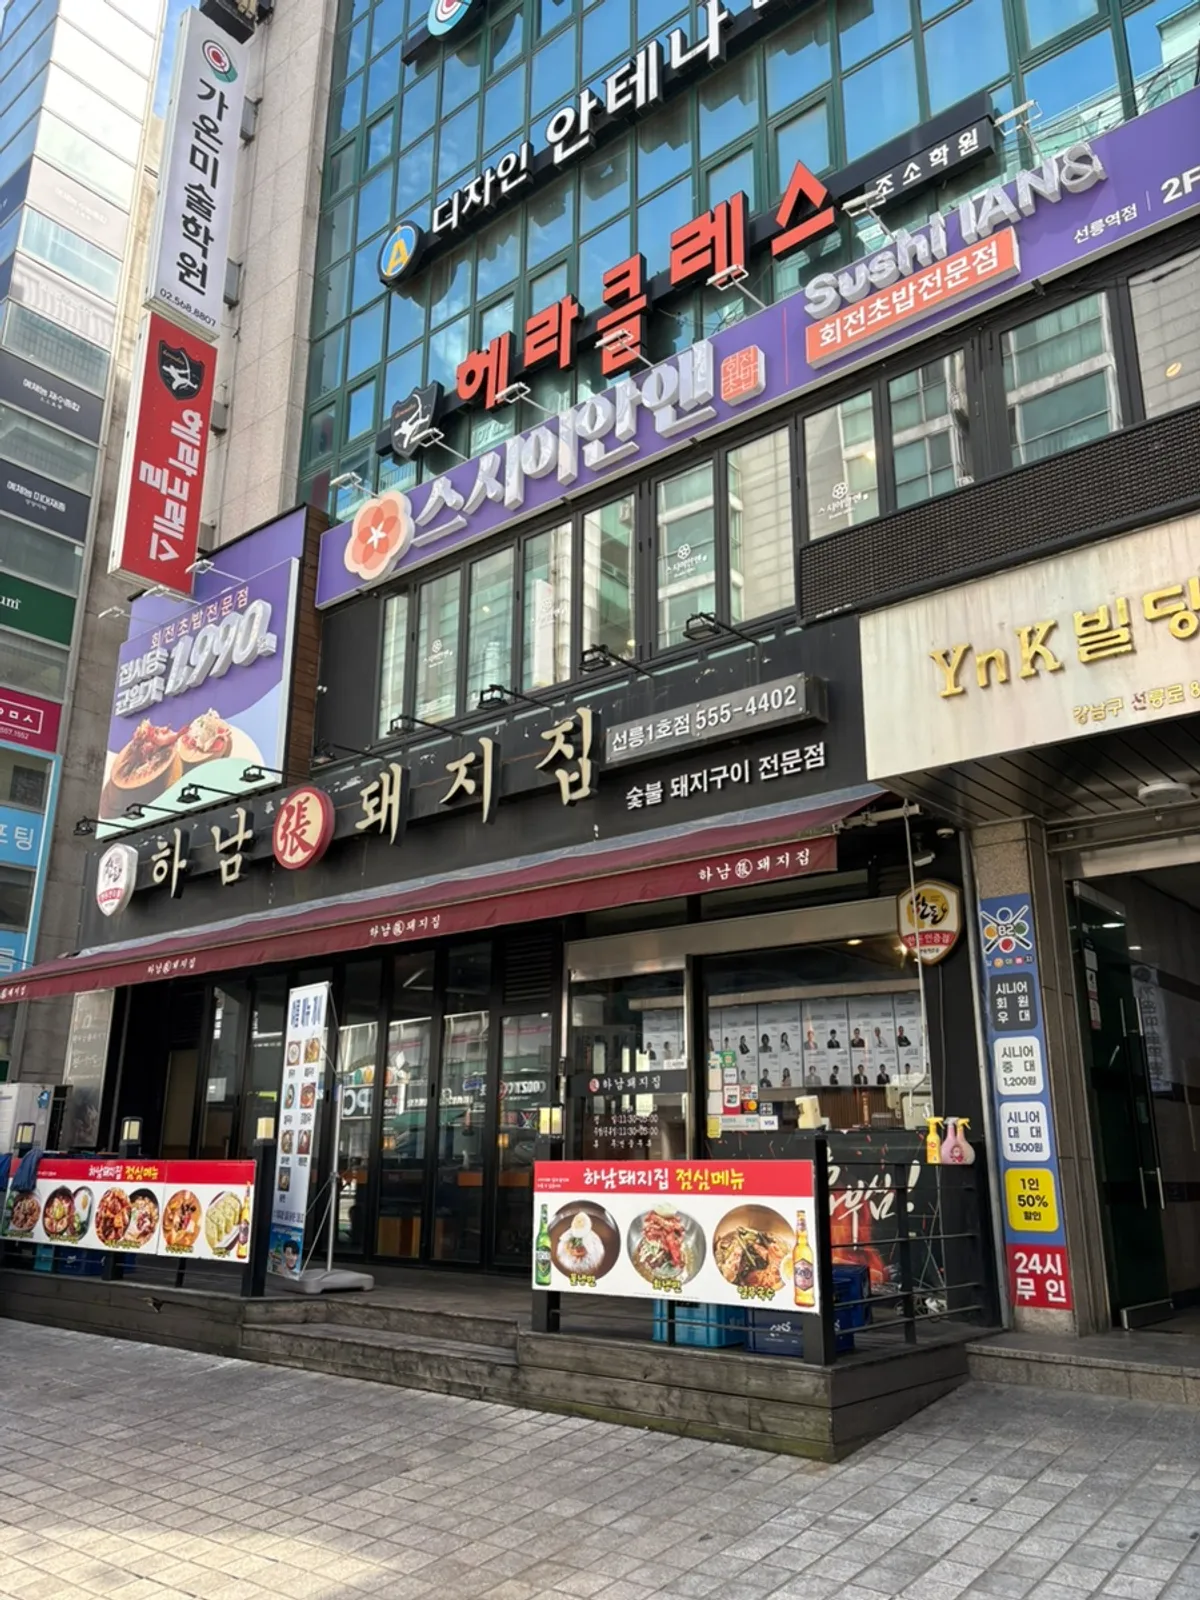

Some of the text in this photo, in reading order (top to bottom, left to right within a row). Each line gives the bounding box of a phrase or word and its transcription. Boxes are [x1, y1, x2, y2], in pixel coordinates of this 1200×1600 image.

[432, 3, 728, 234] 디자인 안테나
[176, 78, 229, 295] 가온미술학원
[1073, 204, 1139, 244] 선릉역점
[456, 128, 979, 410] 헤라클레스 조소학원
[804, 211, 947, 320] Sushi
[818, 240, 999, 347] 회전초밥전문점
[160, 288, 216, 328] 02.568.8807
[410, 339, 717, 548] 스시이안앤
[139, 409, 204, 563] 헤라클레스
[151, 586, 248, 650] 회전초밥전문점
[930, 576, 1200, 698] YnK 빌딩
[610, 684, 798, 753] 선릉1호점 555-4402
[1073, 697, 1124, 724] 강남구
[1131, 683, 1186, 712] 선릉로
[151, 807, 253, 899] 하남
[356, 707, 595, 845] 돼지집
[625, 741, 826, 810] 숯불 돼지구이 전문점
[995, 981, 1028, 995] 시니어
[1001, 1045, 1034, 1058] 시니어
[1007, 1111, 1041, 1124] 시니어
[583, 1167, 669, 1190] 하남돼지집
[675, 1168, 745, 1191] 점심메뉴
[1017, 1194, 1049, 1208] 50%
[1019, 1177, 1040, 1191] 1인
[1024, 1210, 1042, 1221] 할인
[1014, 1252, 1063, 1276] 24시
